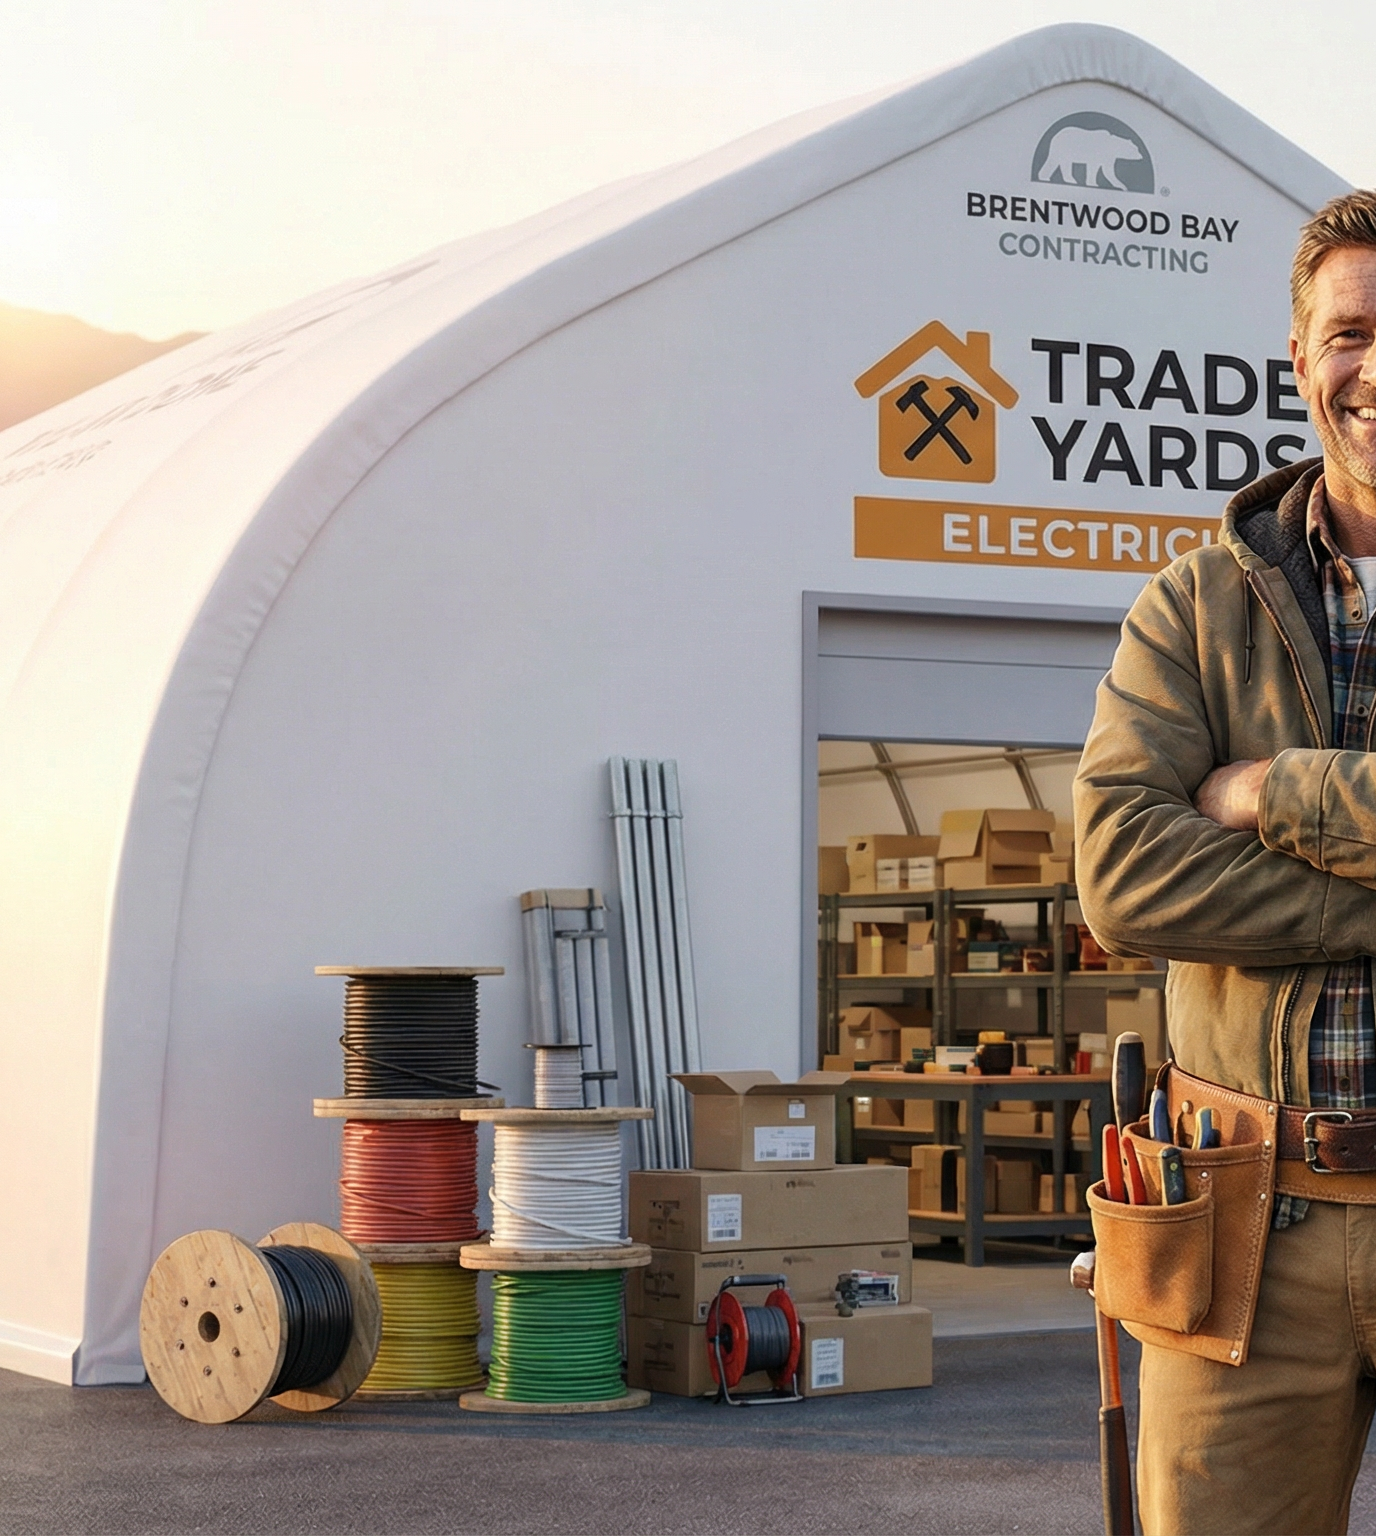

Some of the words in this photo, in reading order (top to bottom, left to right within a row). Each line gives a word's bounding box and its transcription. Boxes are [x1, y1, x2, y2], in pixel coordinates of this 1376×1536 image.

[966, 191, 1171, 237] BRENTWOOD
[1181, 213, 1240, 244] BAY
[998, 231, 1209, 275] CONTRACTING
[1031, 337, 1308, 423] TRADE
[1030, 415, 1307, 492] YARDS
